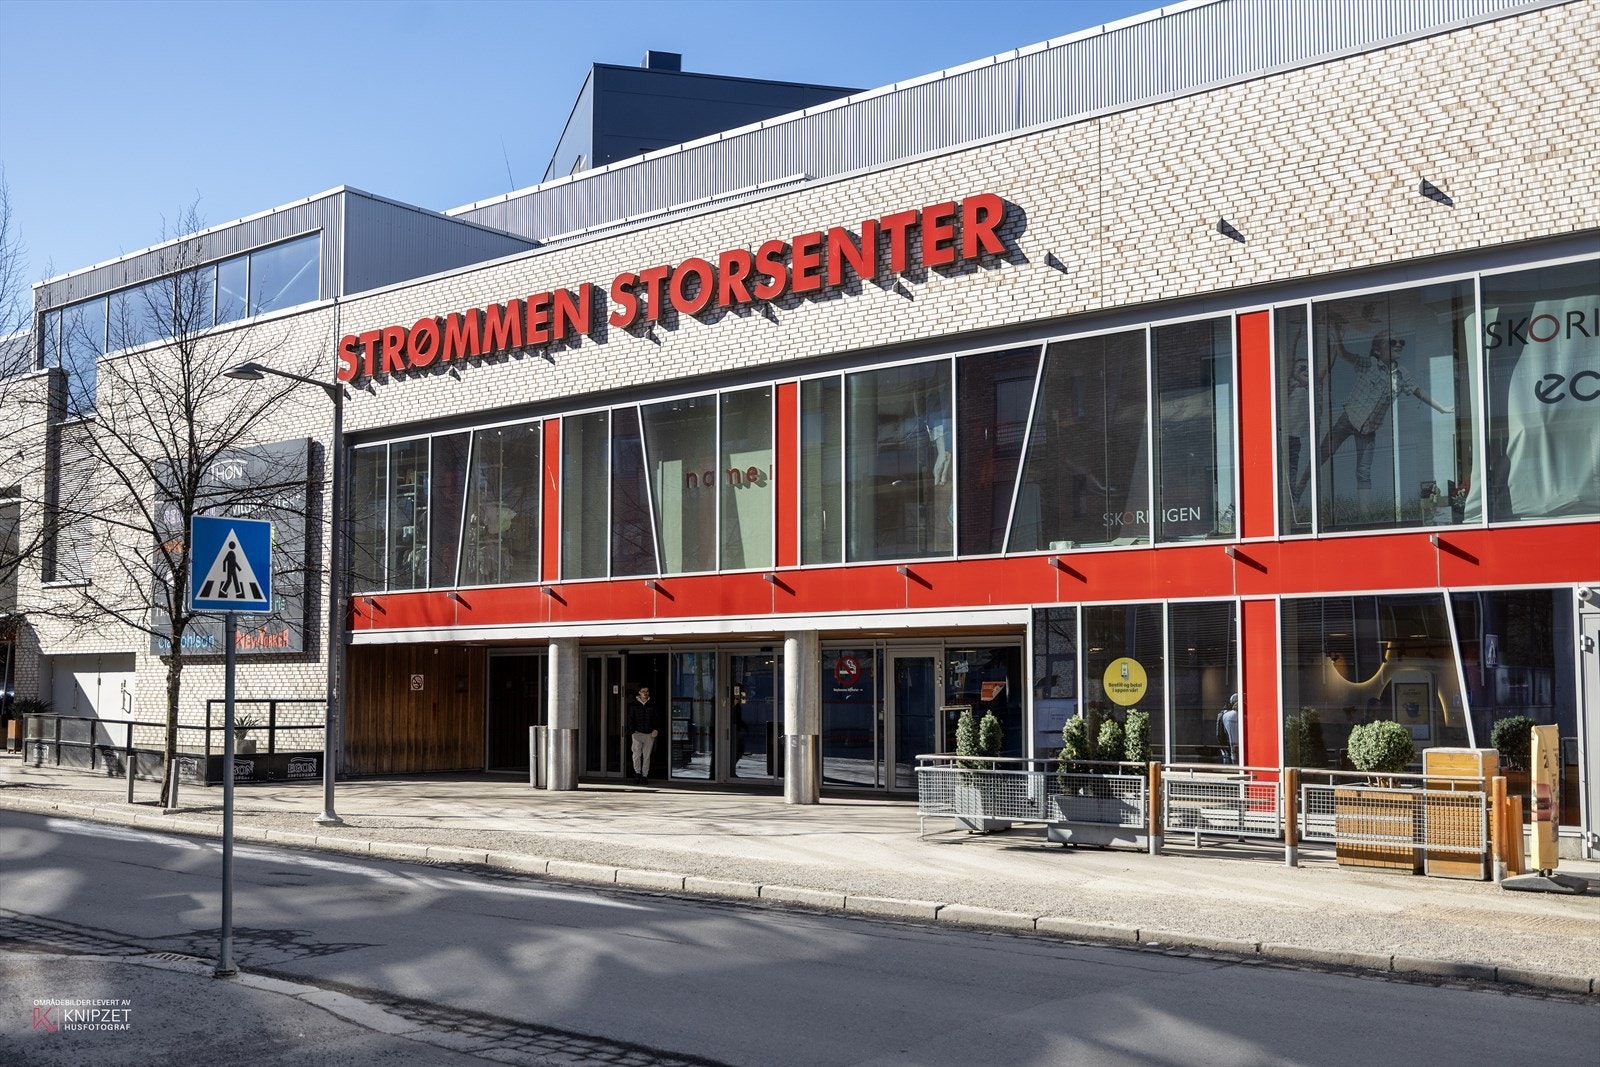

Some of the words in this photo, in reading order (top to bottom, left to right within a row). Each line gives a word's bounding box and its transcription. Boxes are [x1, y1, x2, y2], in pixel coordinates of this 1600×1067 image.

[337, 282, 593, 382] STRØMMEN
[608, 193, 1007, 328] STORSENTER
[210, 463, 243, 481] THON
